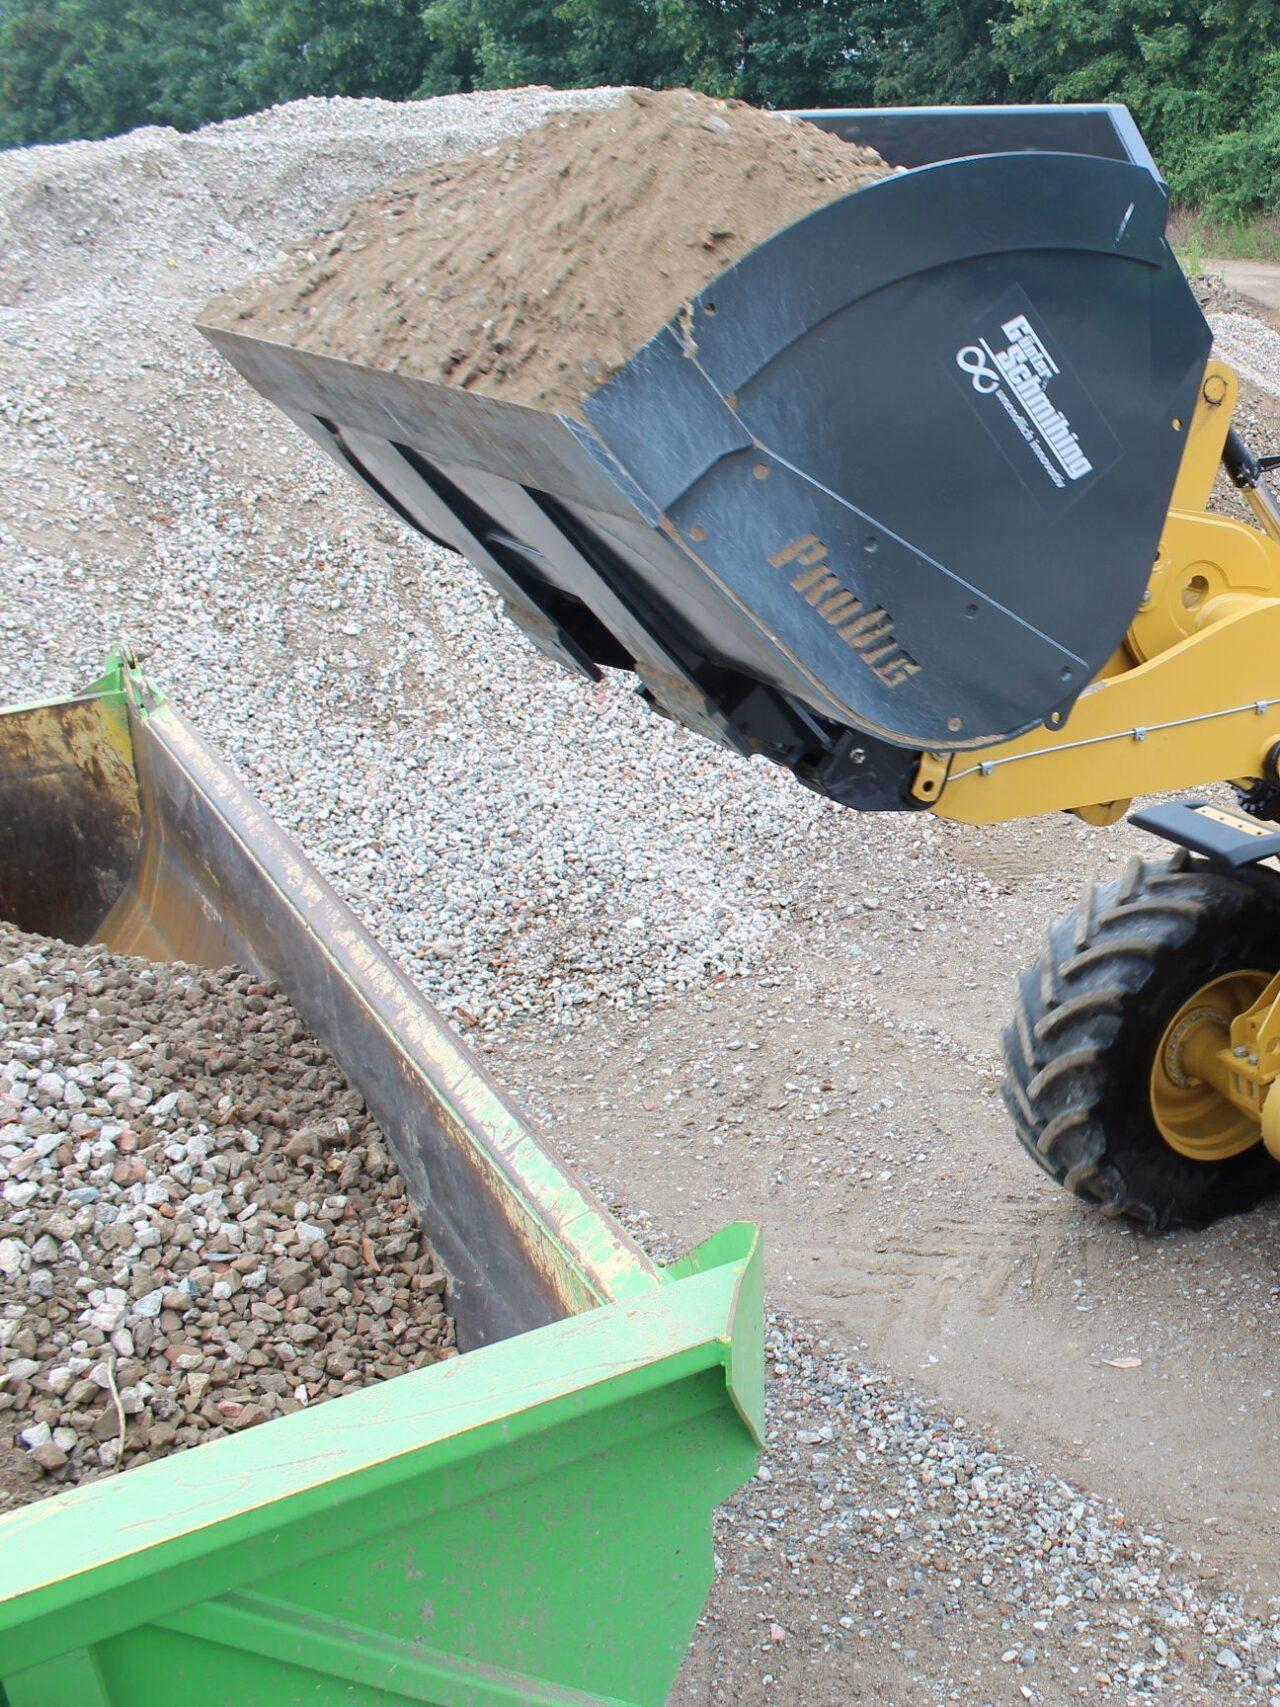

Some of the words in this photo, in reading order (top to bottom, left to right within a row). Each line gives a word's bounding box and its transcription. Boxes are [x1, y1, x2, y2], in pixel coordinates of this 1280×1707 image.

[995, 390, 1034, 442] unendlich
[1030, 439, 1066, 488] innovativ
[996, 343, 1093, 479] Schmihing
